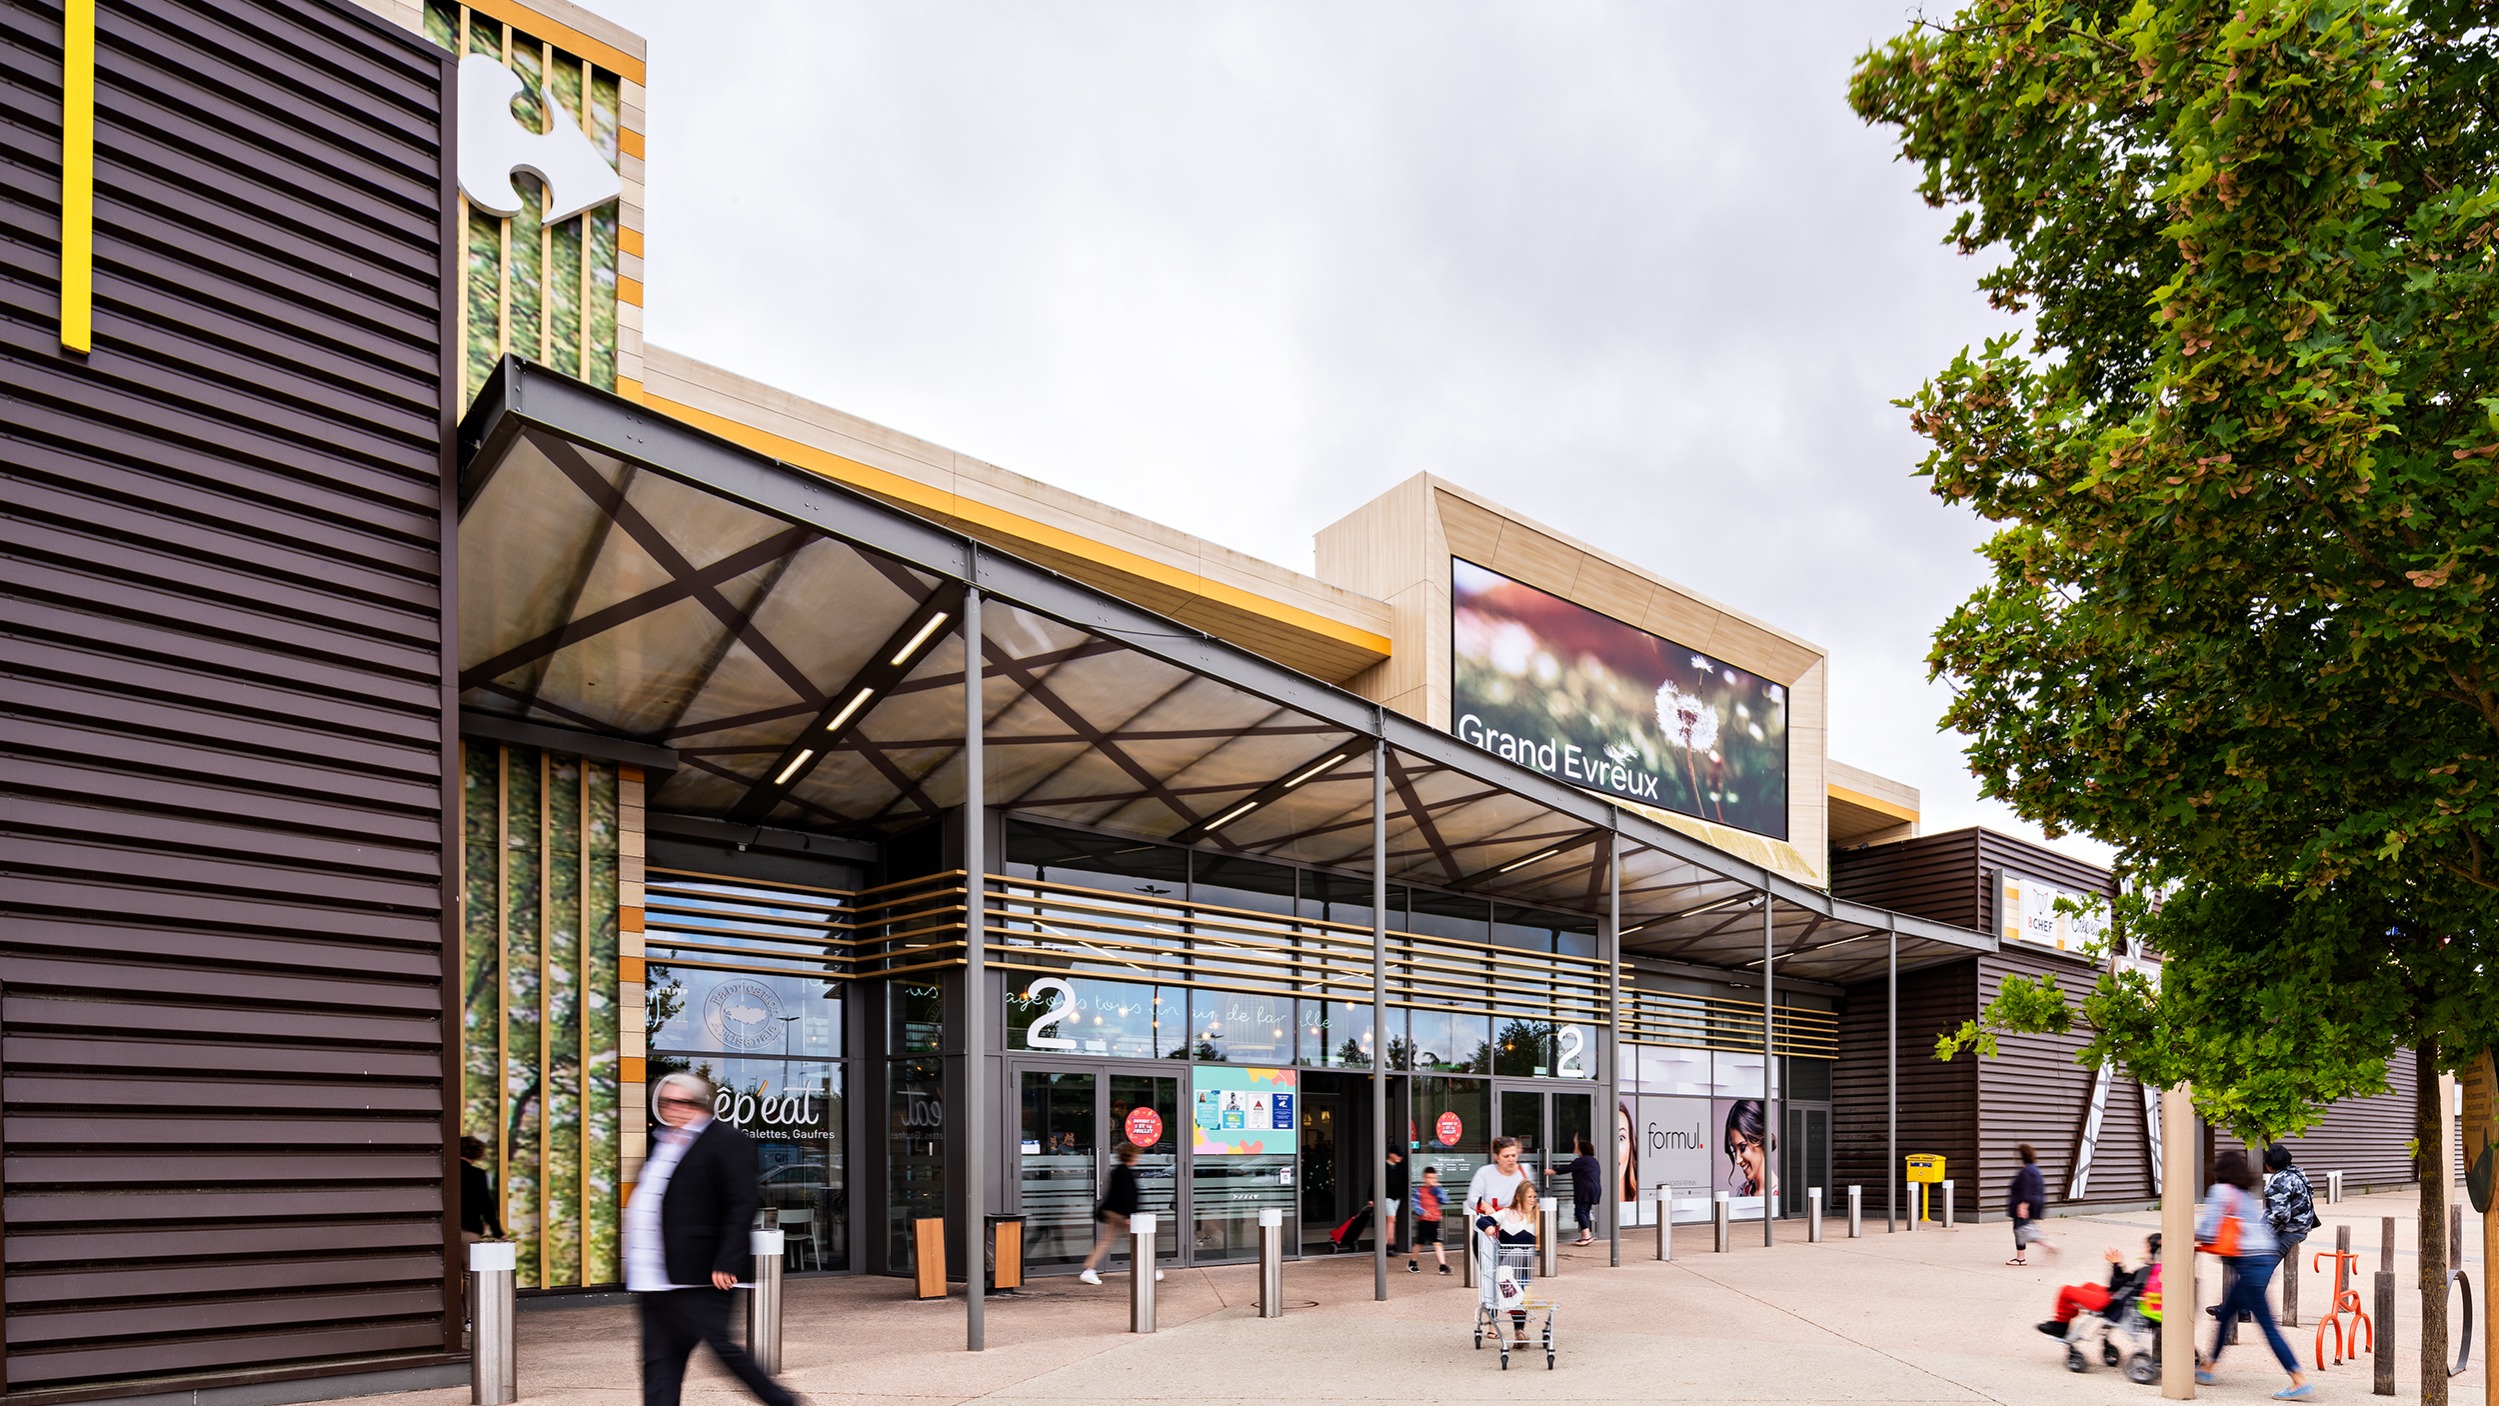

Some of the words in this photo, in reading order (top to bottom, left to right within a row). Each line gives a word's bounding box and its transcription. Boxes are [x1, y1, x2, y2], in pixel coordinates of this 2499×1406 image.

[1458, 714, 1556, 773] Grand
[1564, 744, 1658, 800] Evreux
[1027, 977, 1077, 1049] 2
[1226, 1003, 1250, 1022] de
[1557, 1025, 1584, 1077] 2
[652, 1073, 825, 1130] Cêp'eat
[793, 1128, 835, 1139] Gaufres
[1648, 1122, 1704, 1158] formul.
